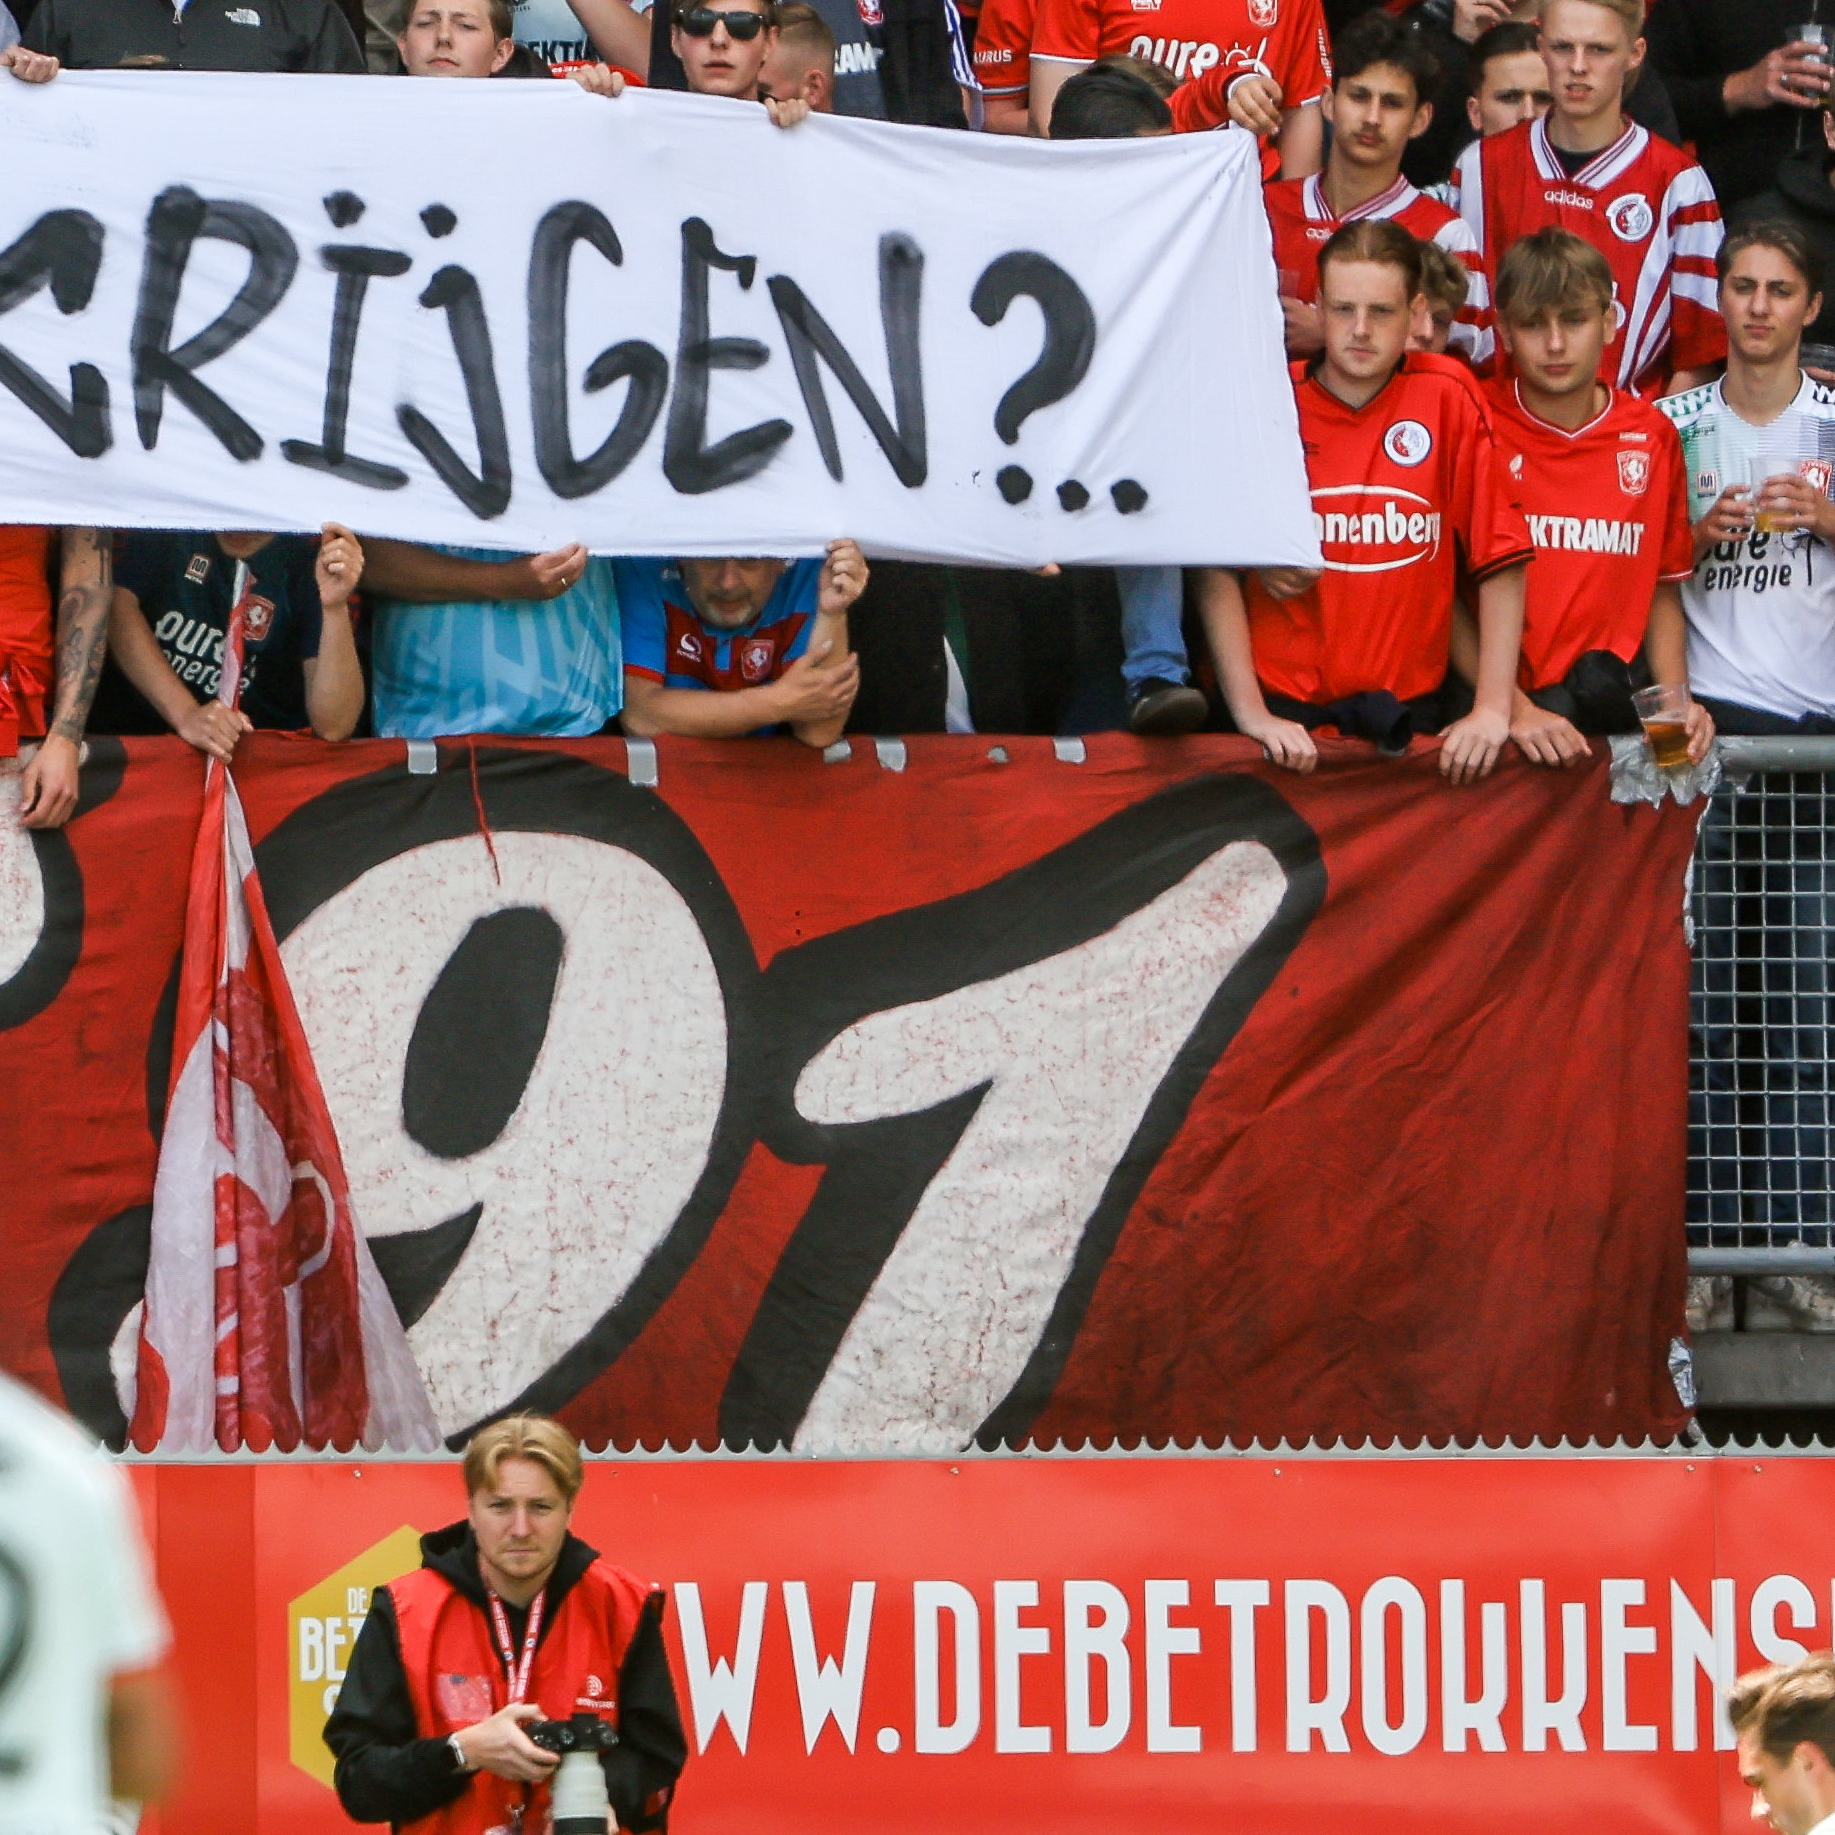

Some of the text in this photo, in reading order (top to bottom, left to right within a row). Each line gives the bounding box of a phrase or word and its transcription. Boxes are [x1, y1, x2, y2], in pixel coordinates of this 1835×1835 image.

[1543, 188, 1594, 211] adidas
[1525, 515, 1646, 555] KTRAMAT
[1705, 564, 1793, 593] energie
